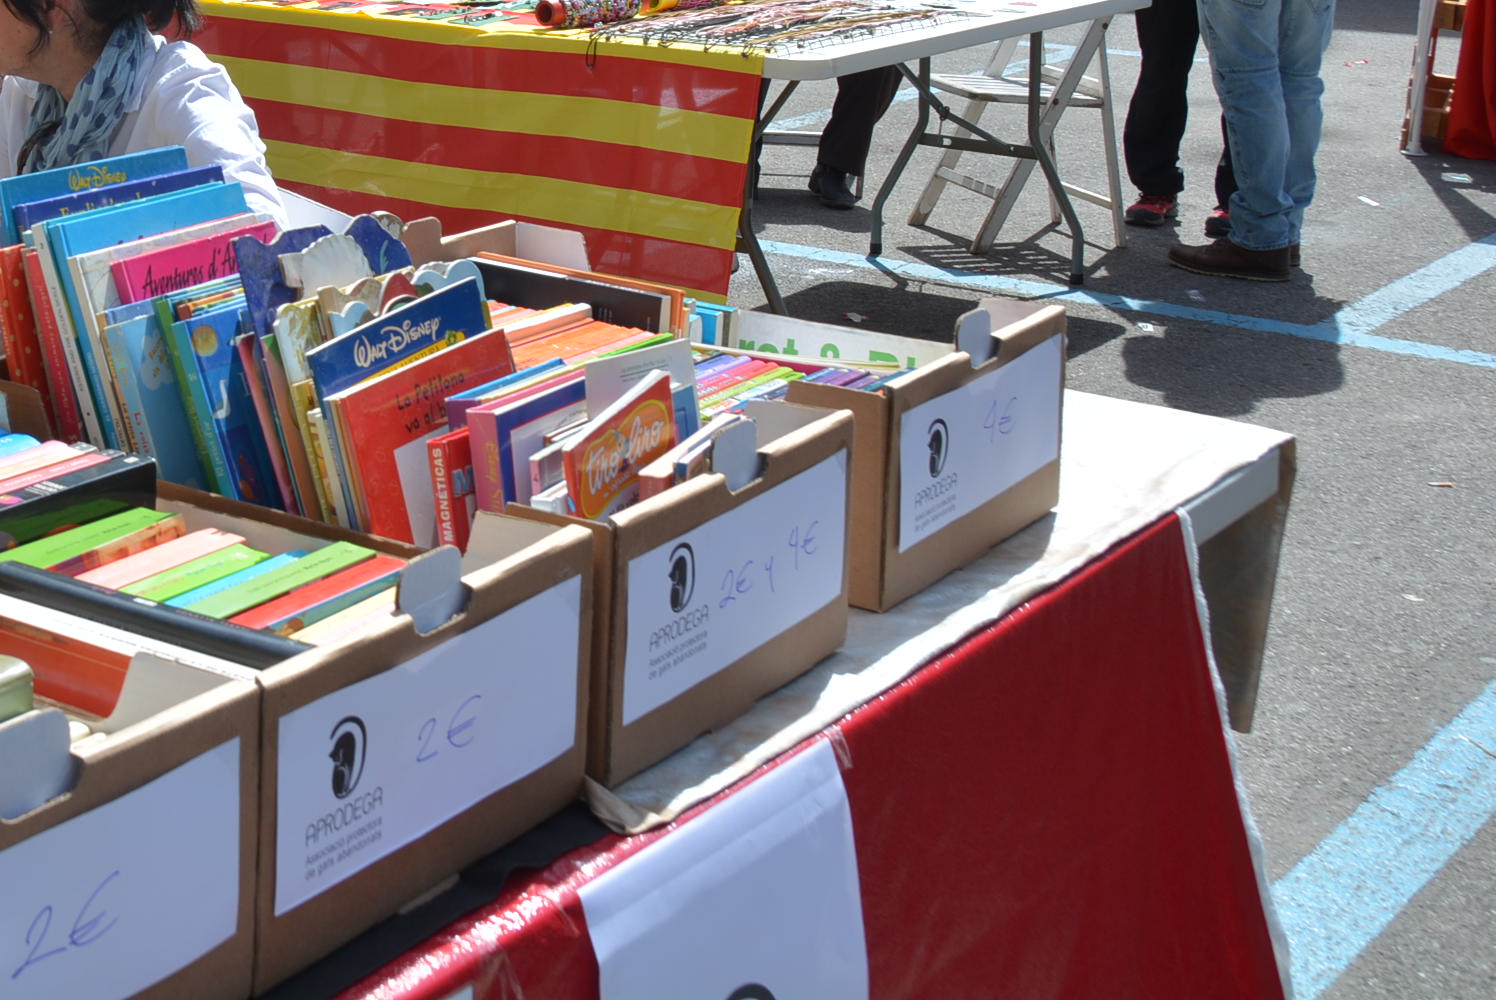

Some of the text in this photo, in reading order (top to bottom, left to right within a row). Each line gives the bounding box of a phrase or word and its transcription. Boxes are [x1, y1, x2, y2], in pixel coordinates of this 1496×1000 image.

[142, 264, 205, 298] Aventures
[395, 396, 412, 411] La
[433, 447, 454, 541] MAGNÉTICAS
[719, 560, 754, 609] 2€
[788, 520, 819, 571] 4€
[649, 604, 709, 652] APRODEGA
[415, 694, 483, 763] 2€
[305, 786, 383, 848] APRODEGA
[11, 870, 120, 980] 2€
